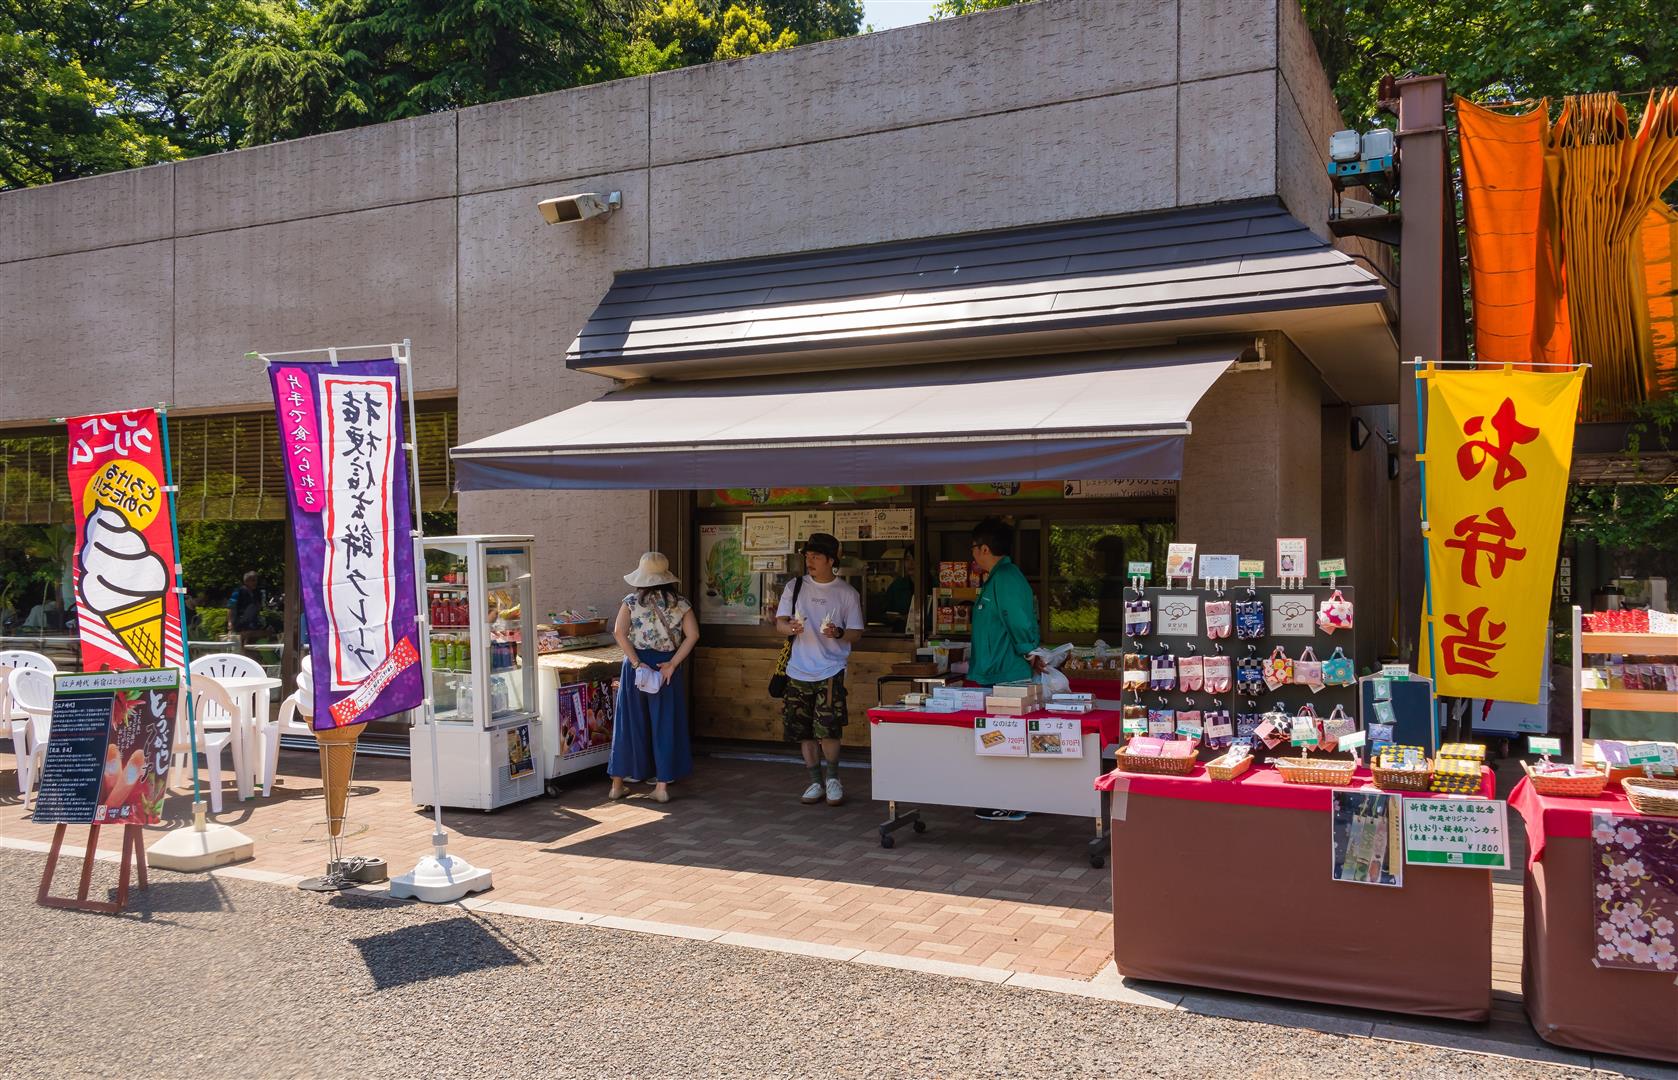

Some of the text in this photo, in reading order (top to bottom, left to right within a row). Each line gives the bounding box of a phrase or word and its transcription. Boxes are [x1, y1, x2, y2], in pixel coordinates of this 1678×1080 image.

[61, 680, 90, 688] 江戸時代
[992, 720, 1019, 728] なのはな
